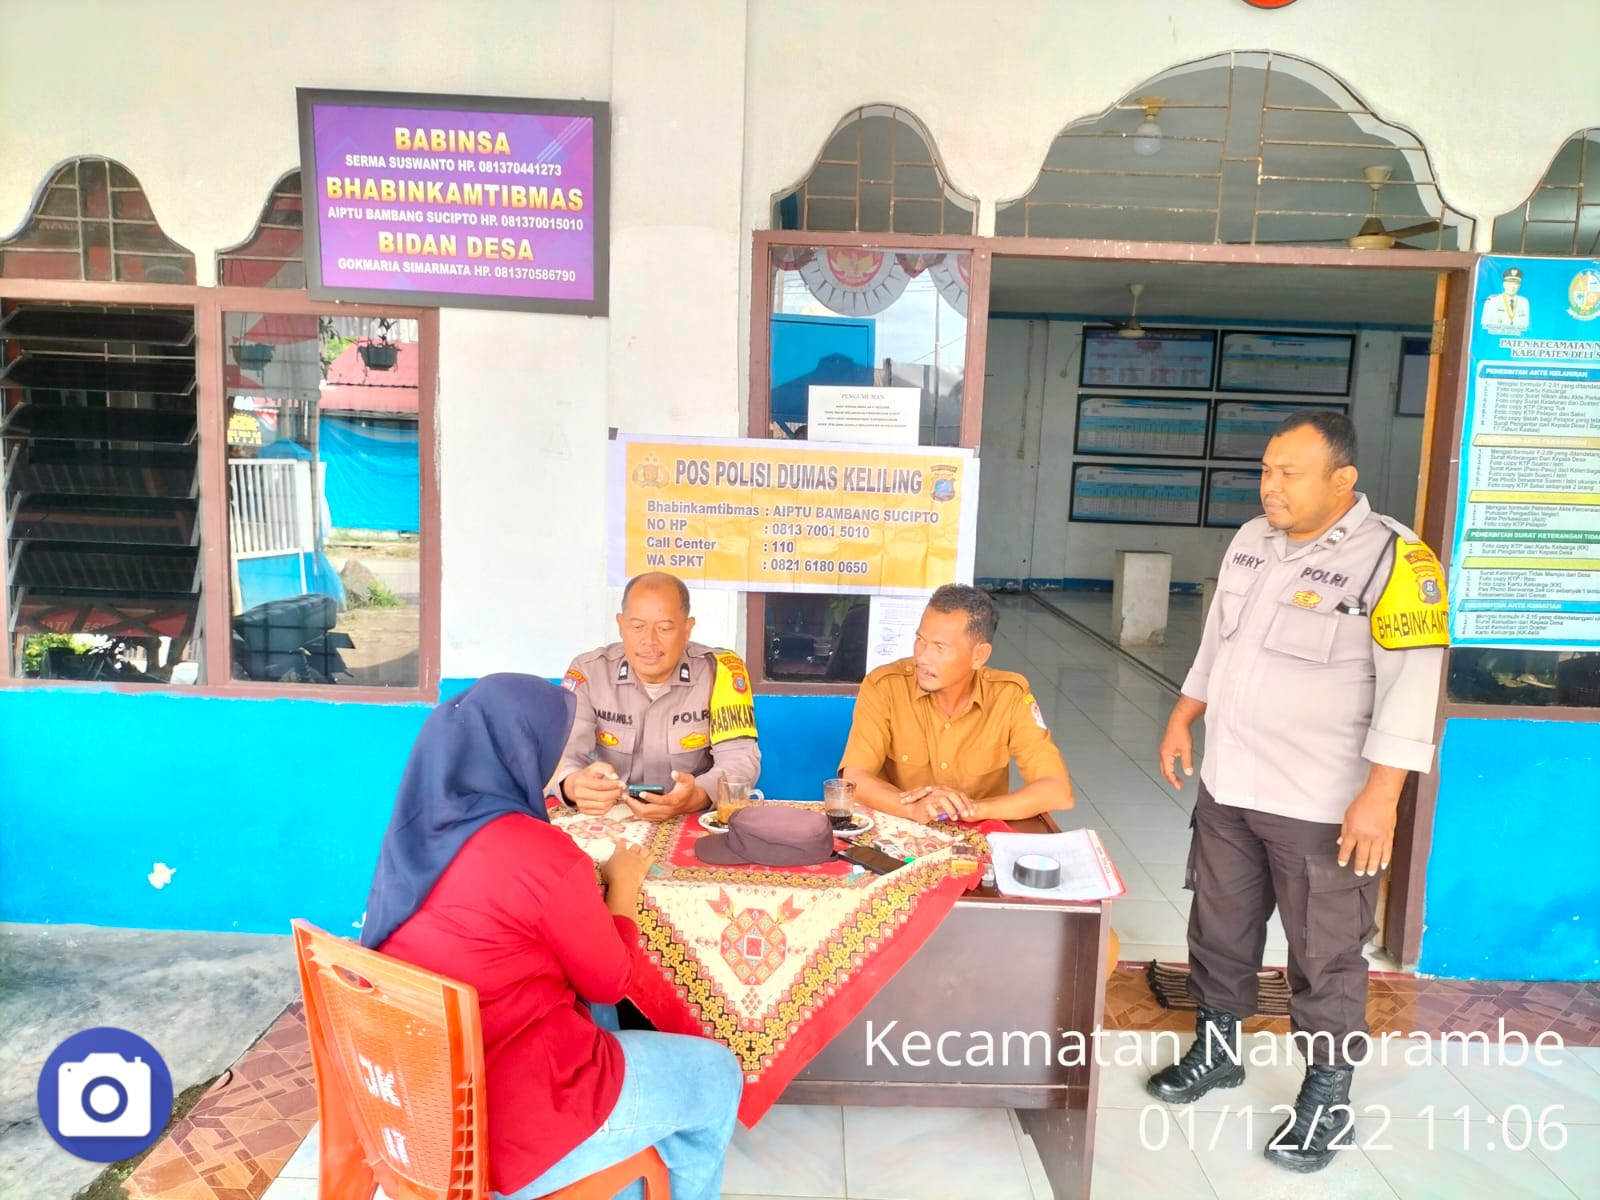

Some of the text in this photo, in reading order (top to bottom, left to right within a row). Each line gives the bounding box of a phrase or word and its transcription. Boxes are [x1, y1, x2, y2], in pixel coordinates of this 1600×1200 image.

[395, 127, 511, 155] BABINSA
[345, 154, 562, 176] SERMA SUSWANTO HP. 081370441273
[326, 176, 584, 211] BHABINKAMTIBMAS
[328, 206, 584, 231] AIPTU BAMBANG SUCIPTO HP. 081370015010
[378, 231, 535, 262] BIDAN DESA
[338, 257, 577, 282] GOKMARIA SIMARMATA HP. 081370586790
[1501, 339, 1531, 348] PATEN
[1533, 341, 1593, 350] KECAMATAN
[1512, 350, 1569, 358] KABUPATEN
[676, 460, 923, 494] POS POLISI DUMAS KELILING
[647, 500, 760, 516] Bhabinkamtibmas
[773, 505, 812, 518] AIPTU
[815, 507, 880, 521] BAMBANG
[883, 510, 939, 523] SUCIPTO
[647, 519, 666, 530] NO
[670, 520, 687, 531] HP
[772, 523, 802, 535] 0813
[806, 525, 835, 537] 7001
[840, 526, 869, 539] 5010
[647, 536, 670, 548] Call
[674, 537, 717, 550] Center
[772, 541, 794, 553] 110
[646, 554, 666, 566] WA
[670, 555, 704, 567] SPKT
[771, 559, 800, 571] 0821
[805, 560, 834, 572] 6180
[838, 562, 868, 574] 0650
[1232, 552, 1265, 570] HERY
[1300, 567, 1349, 588] POLRI
